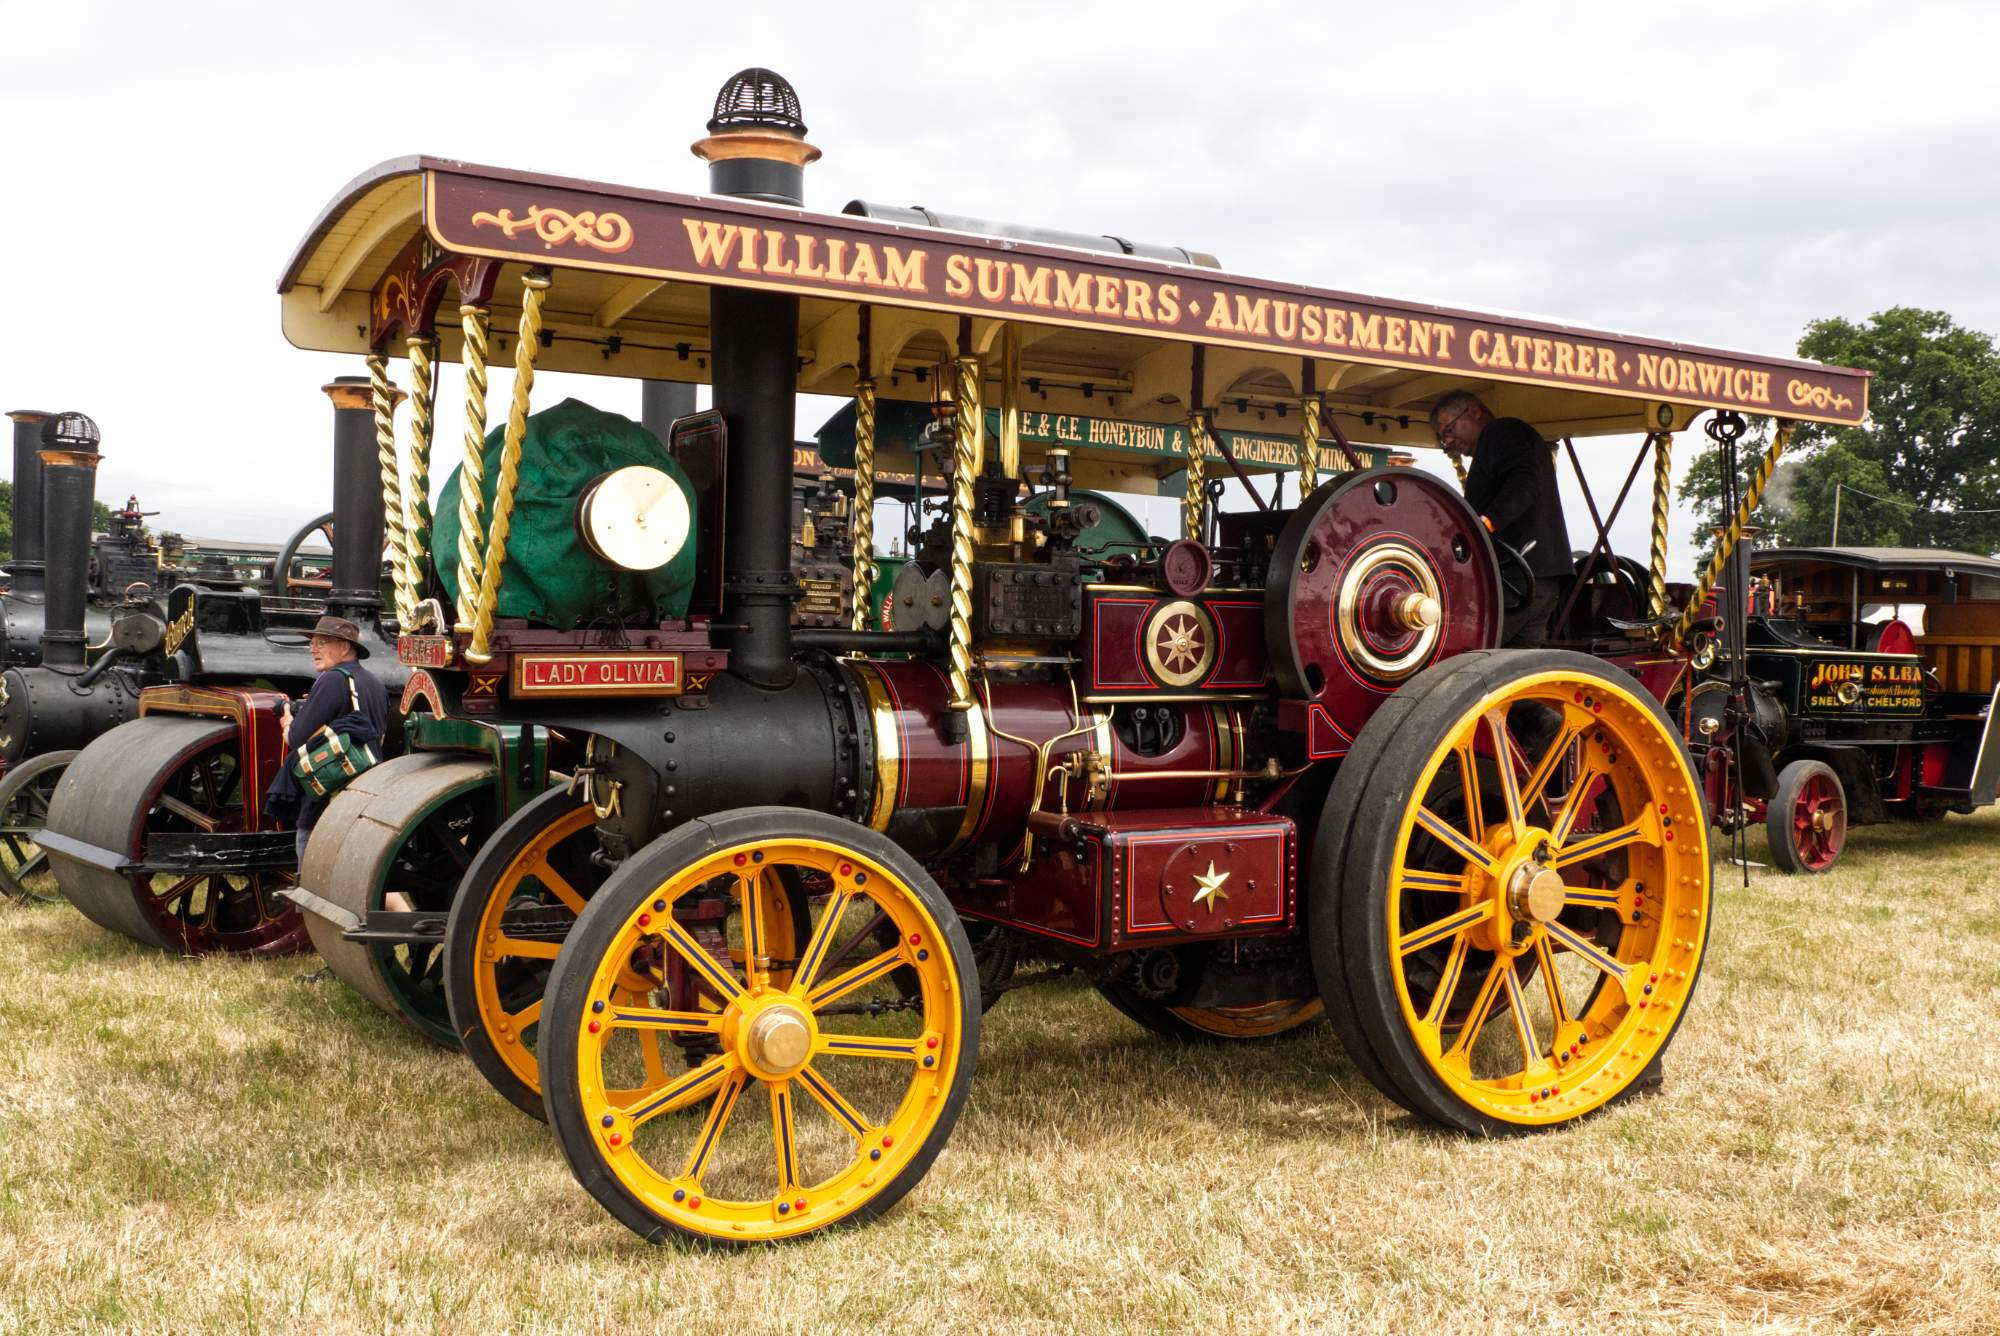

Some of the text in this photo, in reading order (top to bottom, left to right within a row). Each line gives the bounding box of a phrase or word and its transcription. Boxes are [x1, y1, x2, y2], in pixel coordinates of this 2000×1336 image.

[682, 218, 1772, 404] WILLIAM SUMMERS AMUSEMENT CATERER NORWICH
[1038, 413, 1050, 437] &
[1089, 419, 1165, 450] HONEYBUN
[1172, 430, 1182, 452] &
[1232, 437, 1298, 466] ENGINEERS
[534, 663, 665, 683] LADY OLIVIA
[1811, 664, 1865, 689] JOHN
[1867, 697, 1922, 707] CHELFORD
